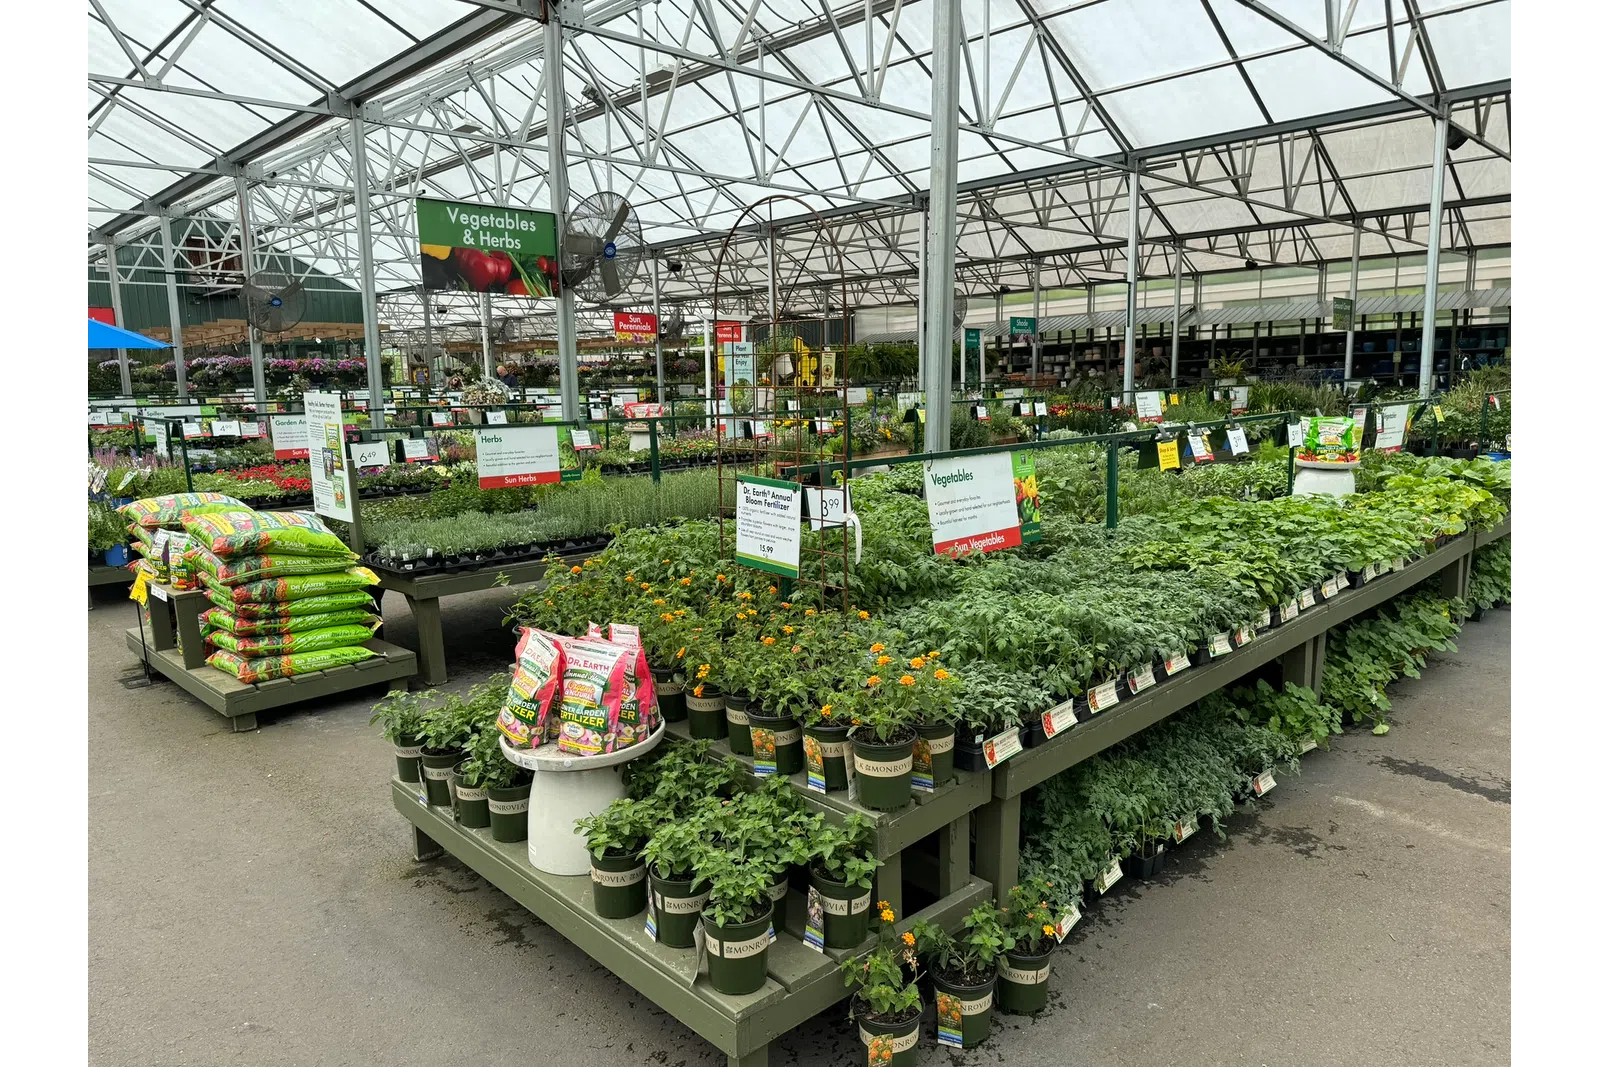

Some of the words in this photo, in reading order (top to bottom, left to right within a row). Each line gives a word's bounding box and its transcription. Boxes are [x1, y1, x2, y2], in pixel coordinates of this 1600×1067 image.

[446, 206, 536, 232] Vegetables
[463, 229, 475, 245] &
[480, 231, 521, 249] Herbs
[629, 315, 641, 323] Sun
[619, 322, 651, 331] Perennials
[1013, 326, 1032, 334] Perennials
[220, 424, 232, 432] 499
[481, 435, 502, 443] Herbs
[360, 452, 376, 462] 649
[505, 476, 517, 484] Sun
[518, 475, 537, 483] Herbs
[931, 469, 973, 488] Vegetables
[771, 491, 792, 502] Annual
[746, 496, 762, 506] Bloom
[764, 499, 789, 511] Fertilizer
[954, 542, 968, 552] Sun
[969, 533, 1005, 550] Vegetables
[760, 544, 773, 553] 15.99
[568, 657, 581, 667] DR.
[583, 660, 610, 672] EARTH
[568, 680, 595, 692] Organic
[576, 708, 605, 717] GARDEN
